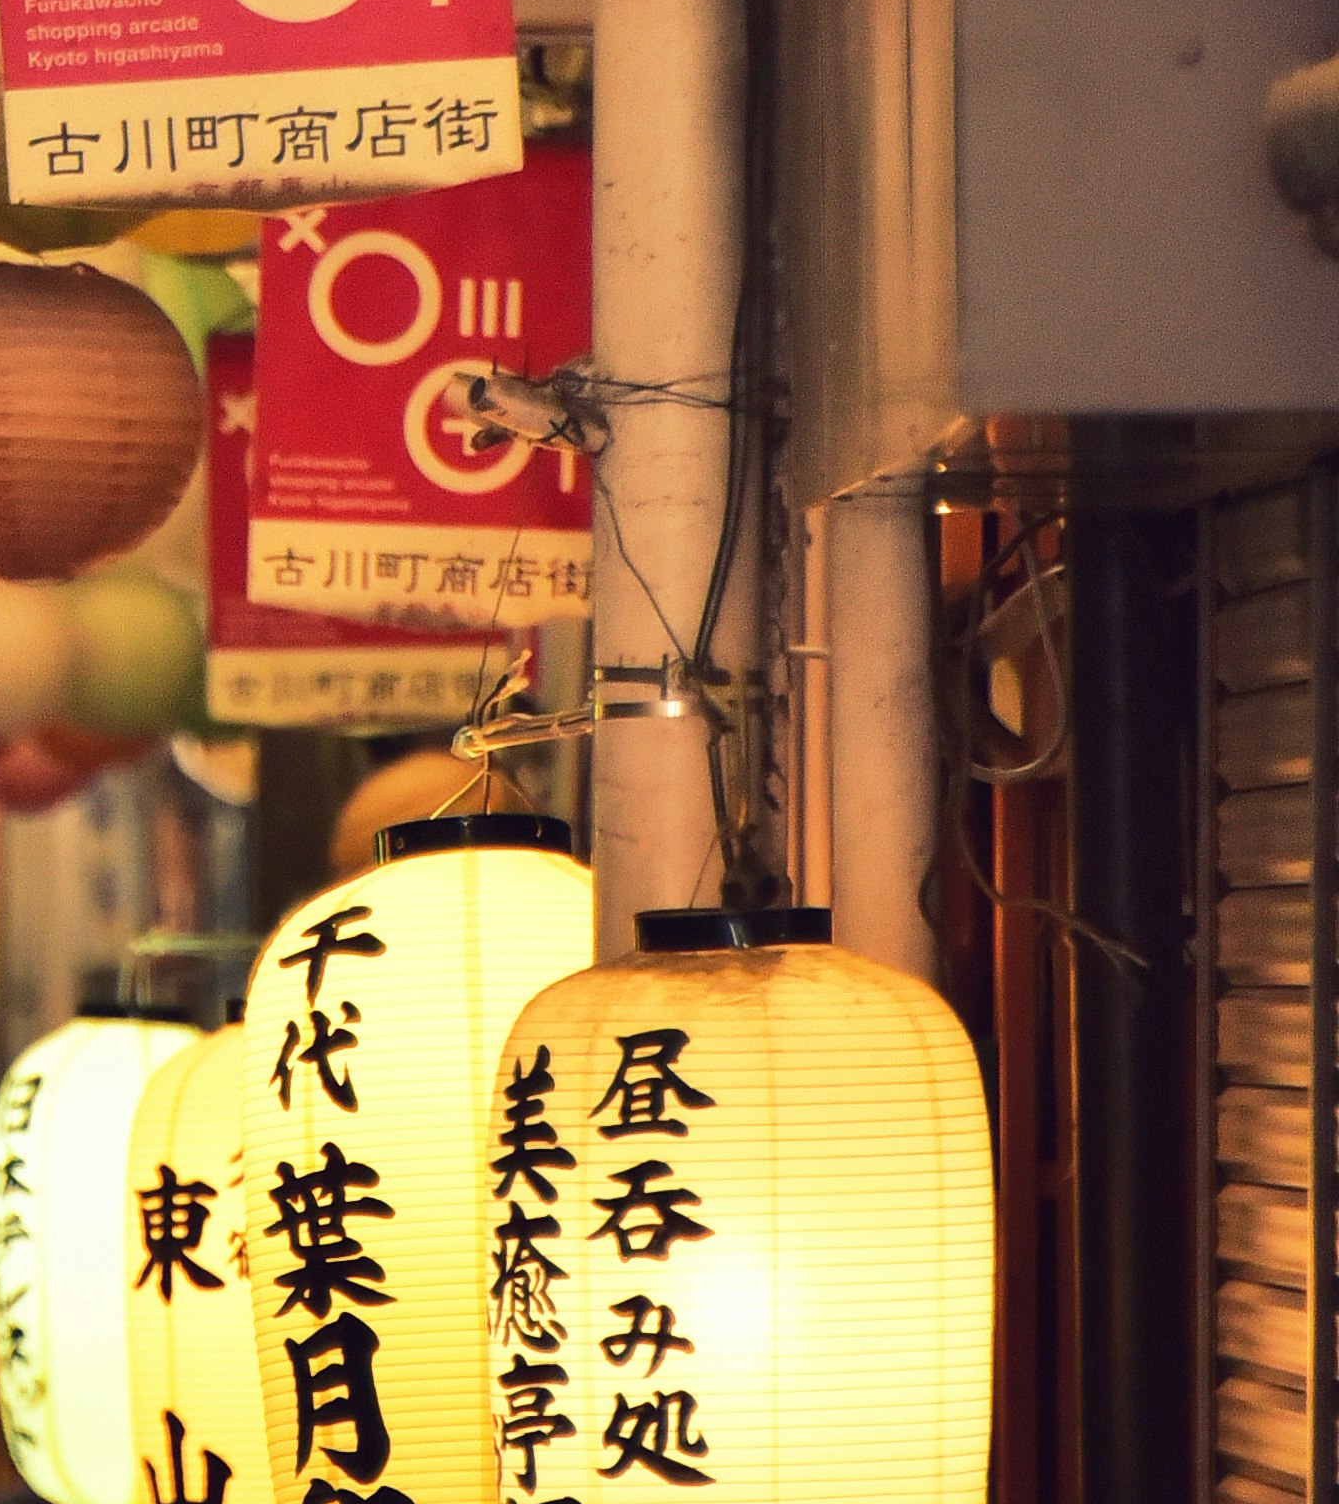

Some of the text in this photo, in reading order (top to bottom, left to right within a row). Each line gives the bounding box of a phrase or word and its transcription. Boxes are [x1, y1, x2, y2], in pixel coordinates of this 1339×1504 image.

[25, 16, 199, 43] shopping arcade
[27, 42, 223, 71] Kyoto higashiyama
[28, 96, 498, 176] 古川町商店街
[262, 547, 591, 600] 古川町商店街
[586, 1028, 717, 1486] 昼呑み処
